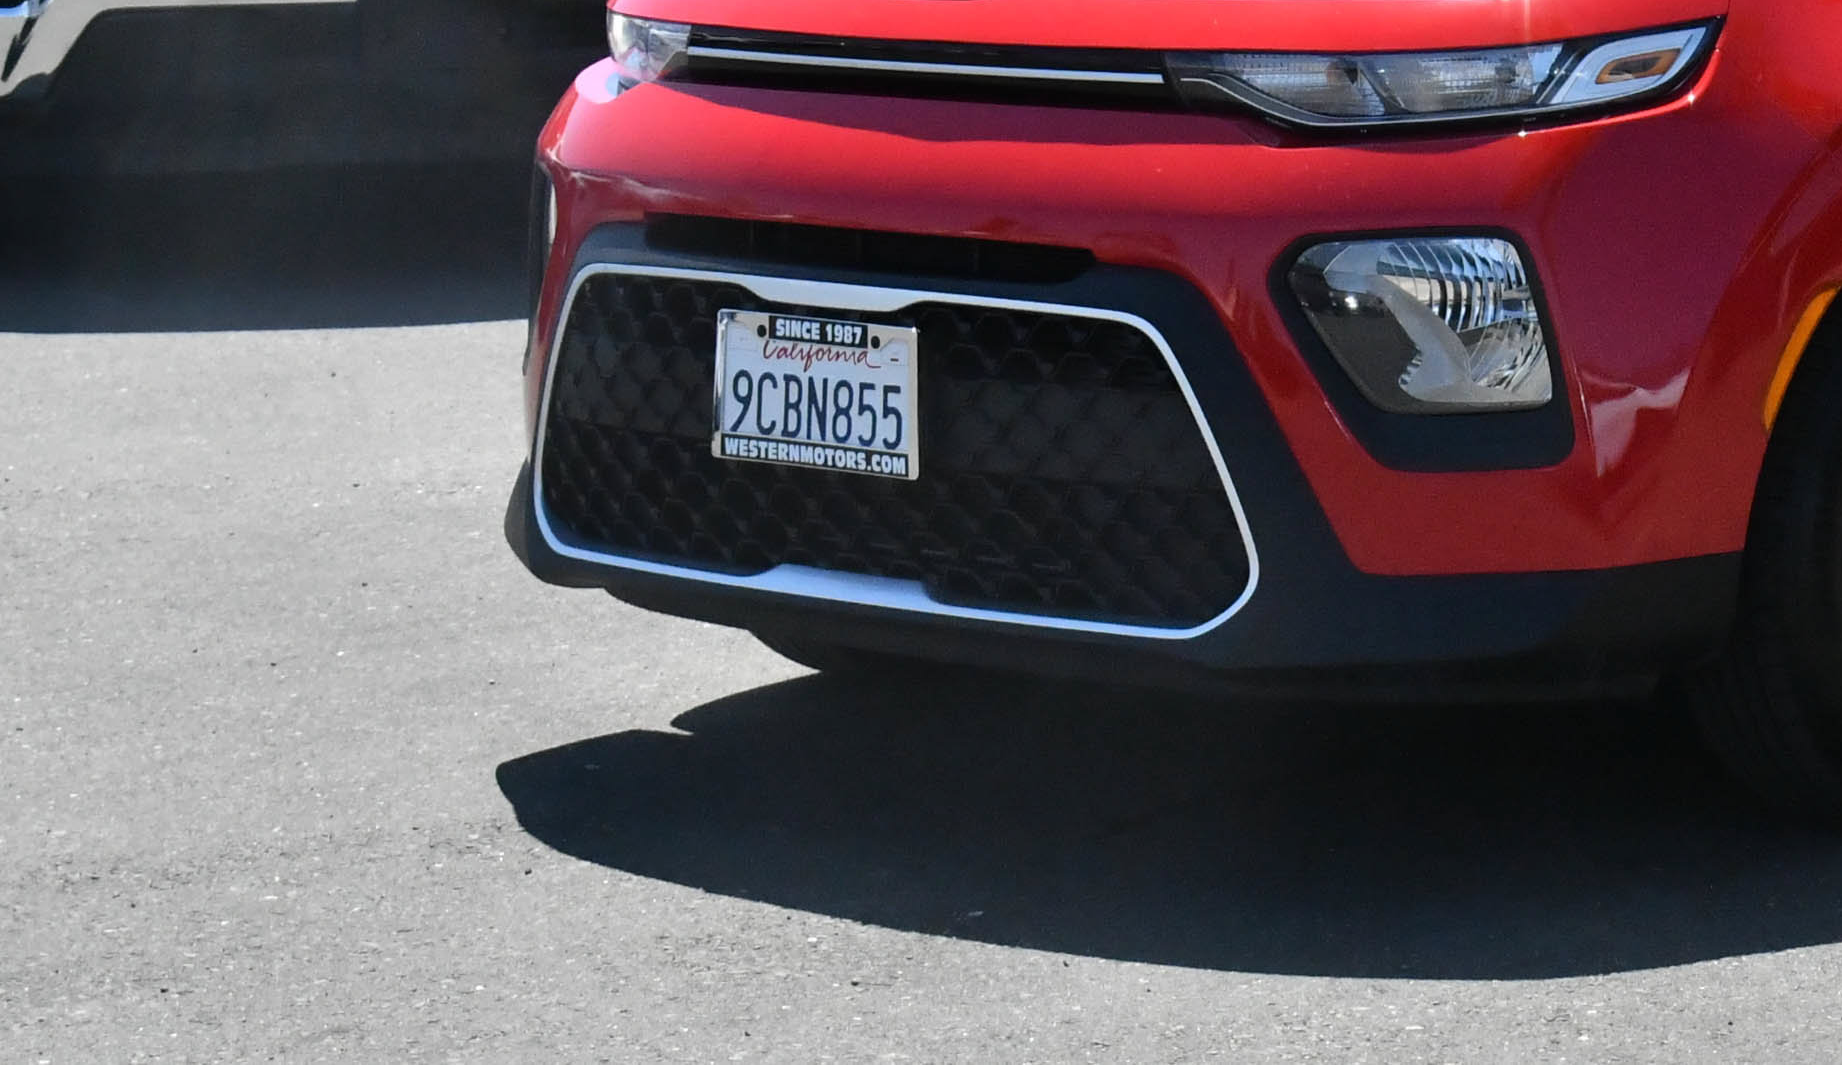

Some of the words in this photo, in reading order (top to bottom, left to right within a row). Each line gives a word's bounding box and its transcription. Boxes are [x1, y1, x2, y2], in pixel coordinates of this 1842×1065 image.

[775, 318, 821, 341] SINCE
[826, 325, 862, 345] 1987
[763, 339, 881, 372] California
[729, 369, 903, 450] 9CBN855
[724, 436, 907, 475] WESTERNMOTORS.COM
